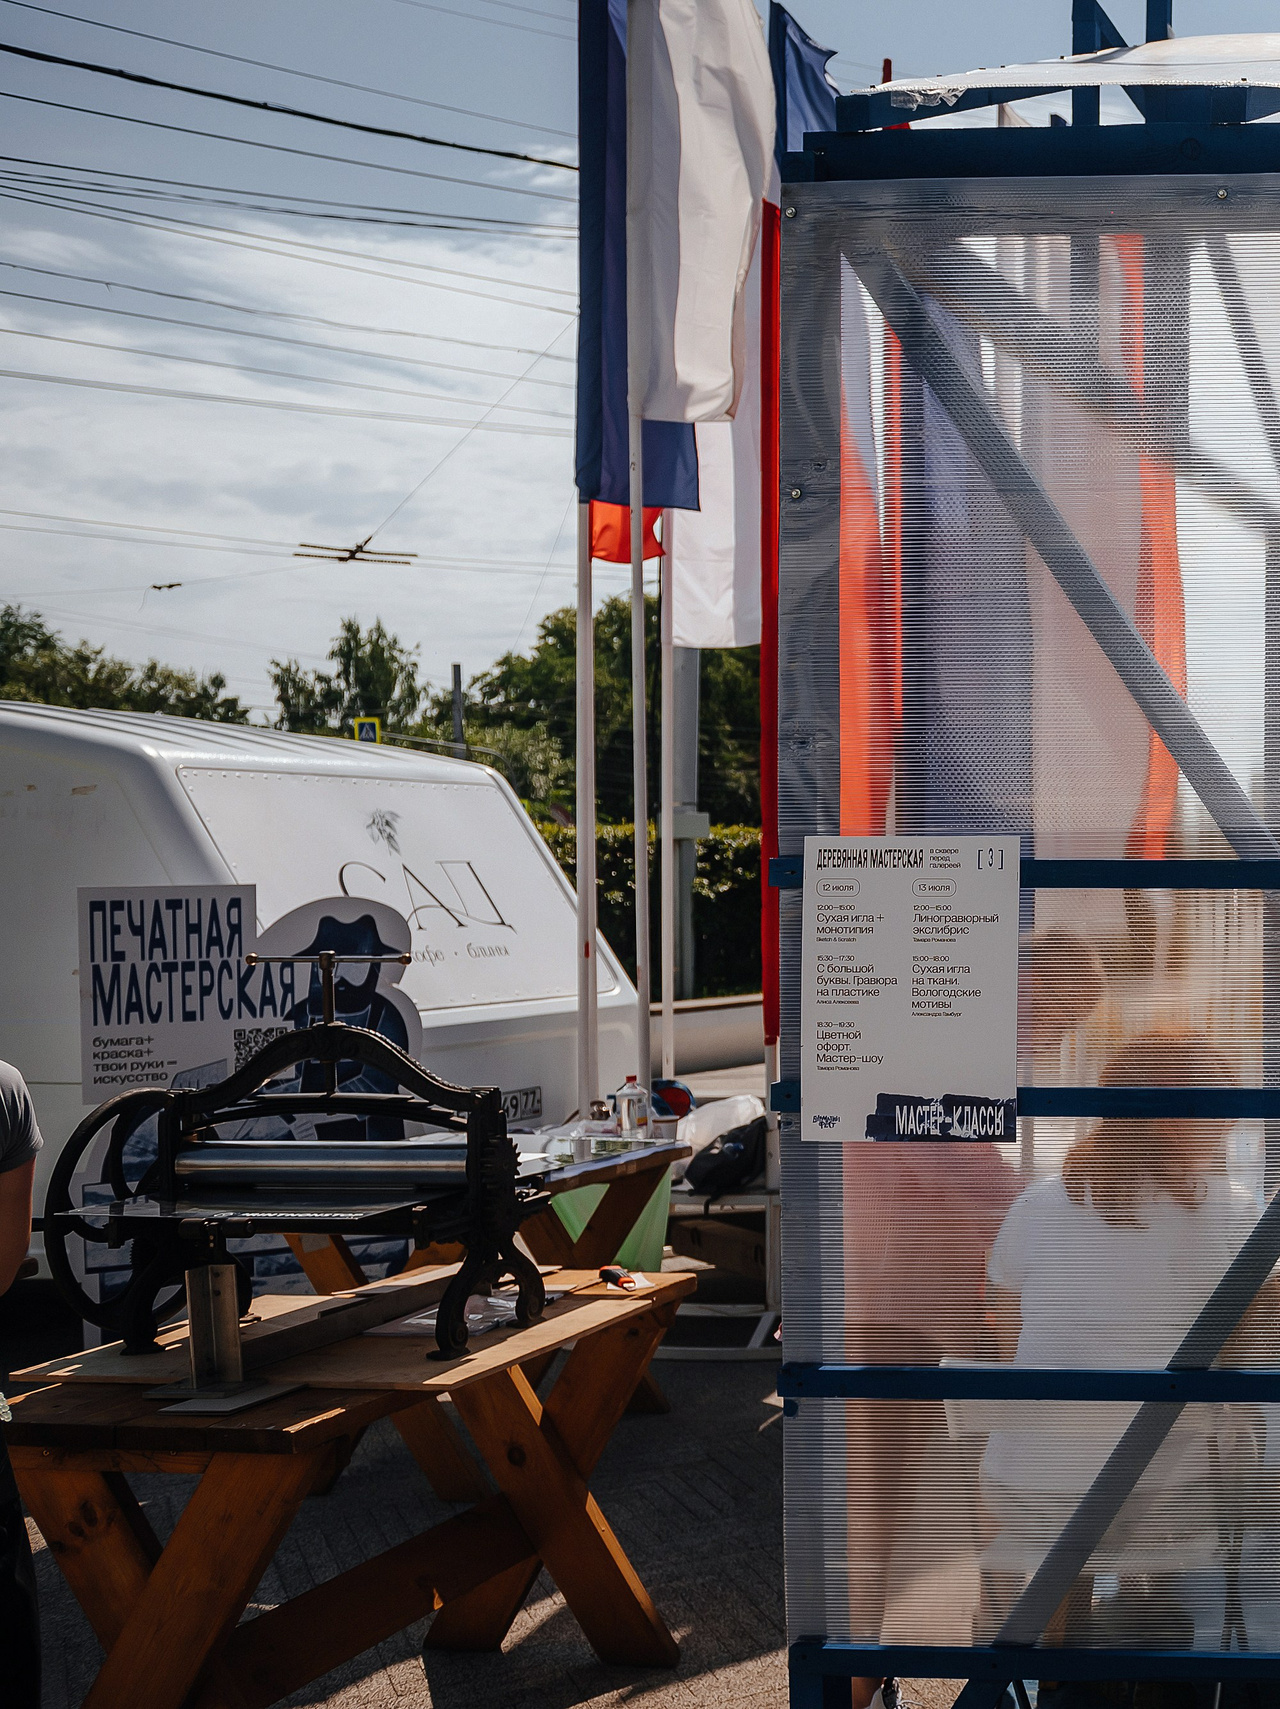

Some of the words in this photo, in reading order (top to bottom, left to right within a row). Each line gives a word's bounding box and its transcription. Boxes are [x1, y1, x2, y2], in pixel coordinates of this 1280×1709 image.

[817, 849, 867, 870] ДЕРЕВЯННАЯ
[870, 849, 923, 868] МАСТЕРСКАЯ
[817, 913, 849, 924] Сухая
[877, 914, 884, 922] +
[913, 914, 999, 924] Линогравюрный
[89, 898, 242, 962] ПЕЧАТНАЯ
[912, 925, 970, 936] экслибрис
[817, 964, 824, 973] С
[827, 964, 874, 973] большой
[912, 964, 944, 975] Сухая
[817, 975, 850, 986] буквы.
[853, 976, 897, 986] Гравюра
[92, 958, 295, 1027] МАСТЕРСКАЯ
[912, 988, 981, 998] Вологодские
[817, 1030, 861, 1041] Цветной
[817, 1043, 851, 1053] офорт.
[817, 1054, 883, 1064] Мастер-шоу
[94, 1062, 127, 1073] твои
[130, 1061, 165, 1075] руки
[93, 1073, 169, 1086] искусство
[895, 1105, 1005, 1136] МАСТЕР-КЛАССЫ
